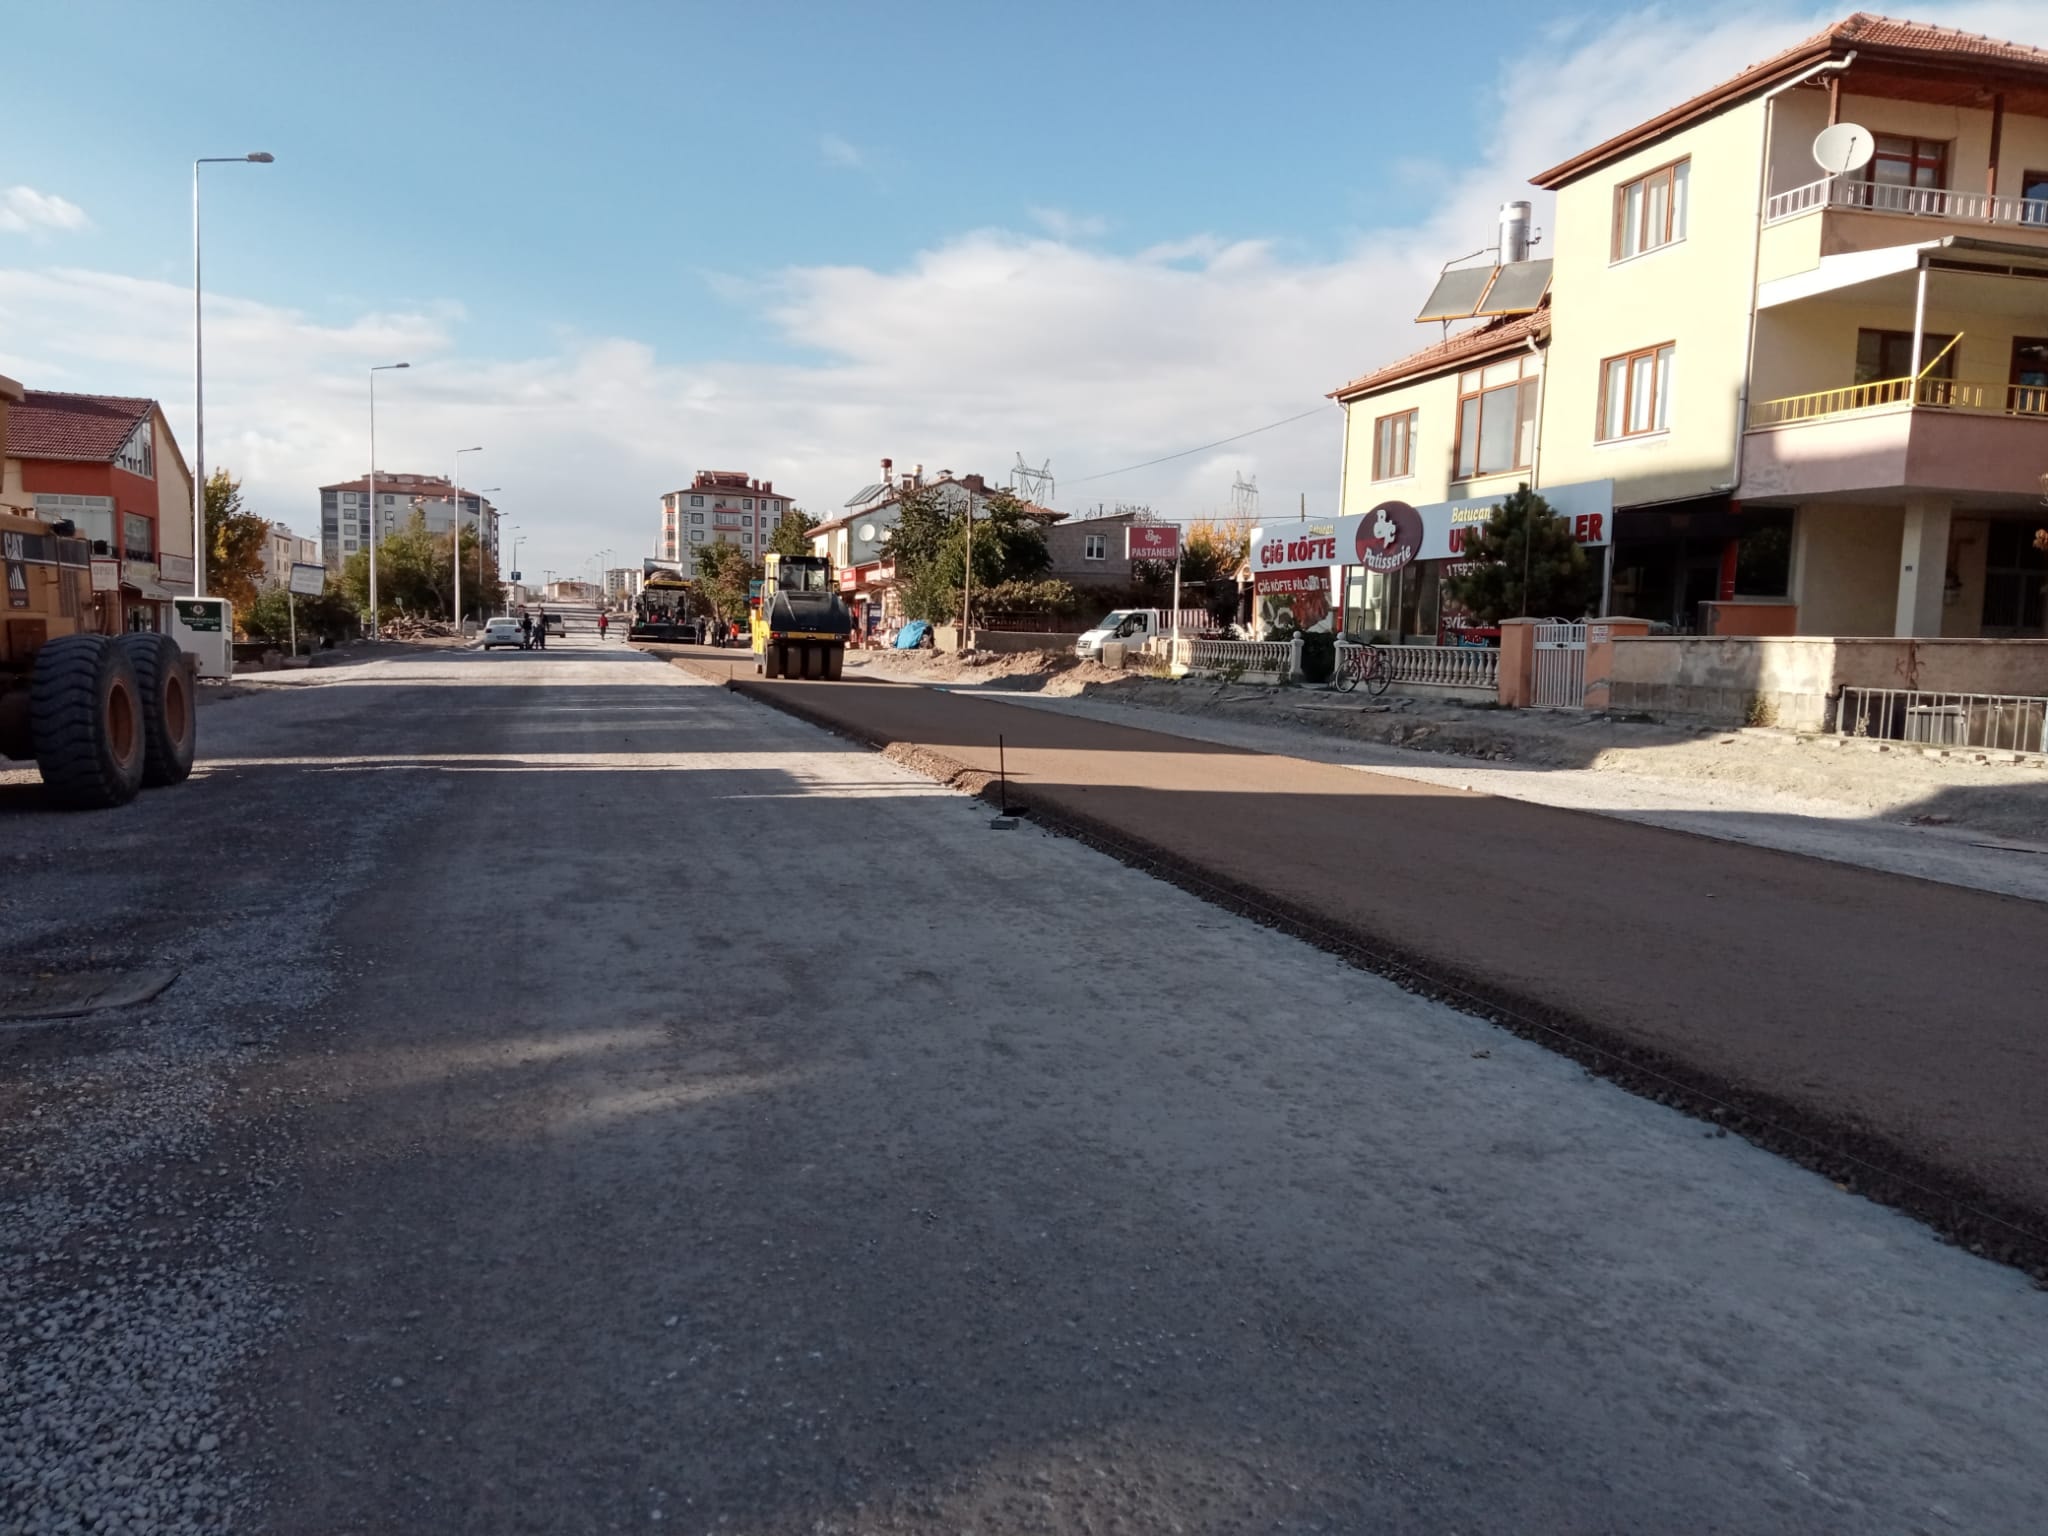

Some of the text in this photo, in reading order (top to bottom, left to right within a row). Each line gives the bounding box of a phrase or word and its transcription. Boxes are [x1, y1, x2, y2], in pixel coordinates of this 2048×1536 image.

[1451, 506, 1491, 523] Batucan
[4, 532, 24, 560] CAT
[1131, 547, 1175, 557] PASTANESİ
[1261, 536, 1336, 568] ÇİĞ KÖFTE
[1363, 545, 1411, 569] Patisserie
[1270, 579, 1292, 592] KÖFTE
